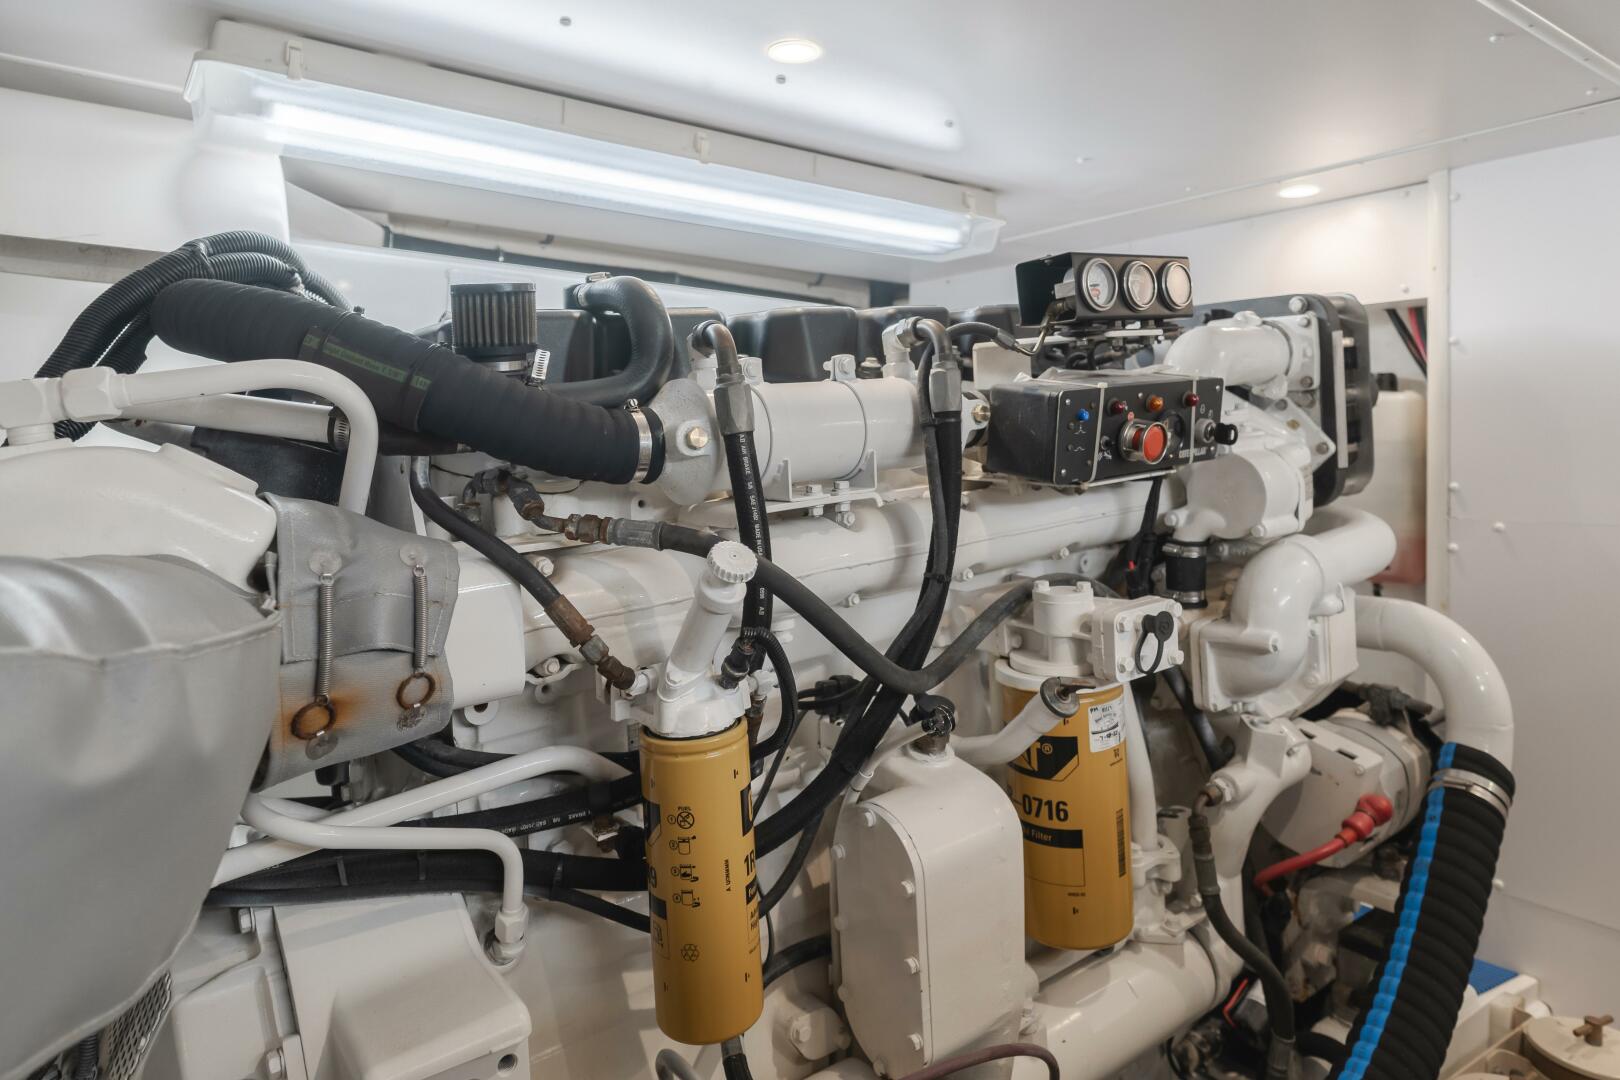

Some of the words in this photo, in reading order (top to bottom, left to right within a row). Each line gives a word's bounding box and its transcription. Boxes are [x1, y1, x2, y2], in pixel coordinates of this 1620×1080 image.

[743, 456, 751, 475] BRAKE
[750, 495, 758, 505] SAE
[754, 523, 762, 539] MADE
